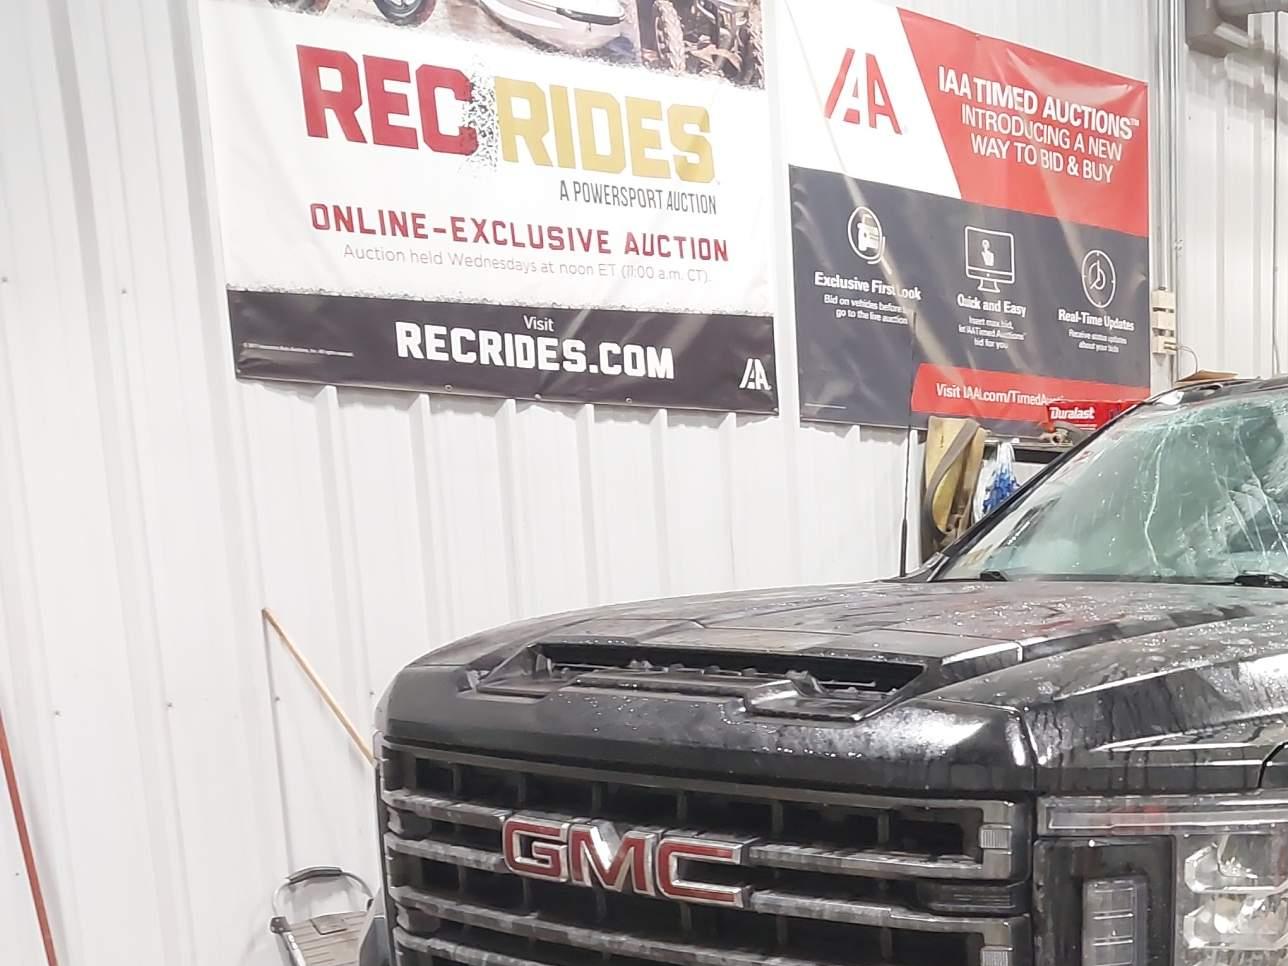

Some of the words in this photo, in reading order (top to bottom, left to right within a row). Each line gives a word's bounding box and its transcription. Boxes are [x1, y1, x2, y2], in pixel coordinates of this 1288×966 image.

[938, 65, 973, 100] IAA
[973, 77, 1038, 116] TIMED
[296, 44, 478, 156] REC
[494, 76, 717, 184] RIDES
[961, 103, 1070, 149] INTRODUCING
[1074, 132, 1085, 153] A
[1088, 137, 1122, 161] NEW
[971, 132, 1011, 160] WAY
[1014, 141, 1038, 167] TO
[1040, 148, 1064, 173] BID
[1067, 155, 1079, 177] &
[1083, 159, 1114, 184] BUY
[559, 179, 570, 202] A
[573, 181, 663, 209] POWERSPORT
[666, 191, 718, 215] AUCTION
[311, 203, 612, 254] ONLINE-EXCLUSIVE
[624, 231, 729, 263] AUCTION
[344, 243, 405, 263] Auction
[410, 249, 443, 265] held
[448, 252, 537, 274] Wednesdays
[541, 261, 555, 273] at
[560, 263, 594, 276] noon
[598, 263, 616, 277] ET
[658, 269, 683, 281] a.m.
[814, 271, 870, 293] Exclusive
[871, 279, 897, 297] First
[824, 294, 838, 305] Bid
[839, 298, 850, 306] on
[523, 313, 555, 333] Visit
[836, 309, 847, 318] go
[857, 310, 869, 320] the
[957, 293, 981, 310] Quick
[982, 300, 1001, 312] and
[1003, 301, 1027, 318] Easy
[1058, 309, 1103, 326] Real-Time
[1103, 315, 1135, 331] Updates
[394, 320, 675, 380] RECRIDES.COM
[936, 382, 961, 399] Visit
[1049, 406, 1096, 420] Duralast
[502, 816, 746, 909] GMC
